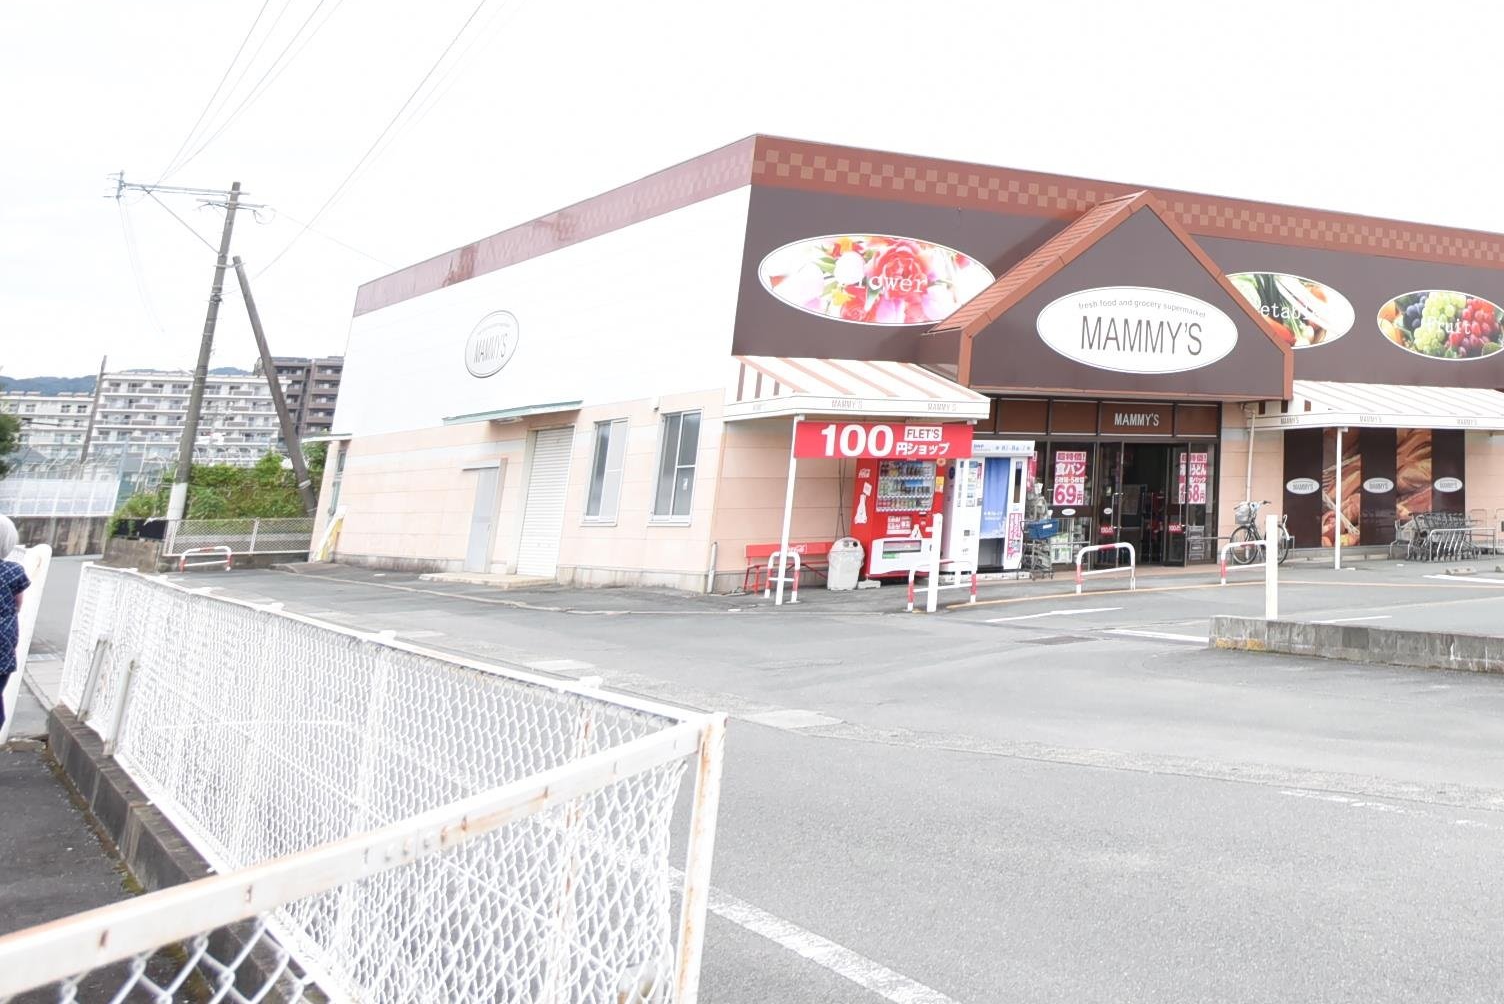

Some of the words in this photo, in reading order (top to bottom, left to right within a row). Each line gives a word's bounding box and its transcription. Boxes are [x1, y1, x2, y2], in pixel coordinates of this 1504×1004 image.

[845, 272, 928, 293] lower
[1100, 299, 1117, 307] food
[1118, 299, 1132, 307] and
[1134, 300, 1162, 309] grocery
[1163, 303, 1207, 318] supermarket
[1080, 315, 1202, 356] MAMMY'S
[1114, 412, 1160, 427] MAMMY'S
[820, 424, 895, 457] 100
[895, 442, 951, 456] 円ショップ
[905, 428, 941, 439] FLET'S
